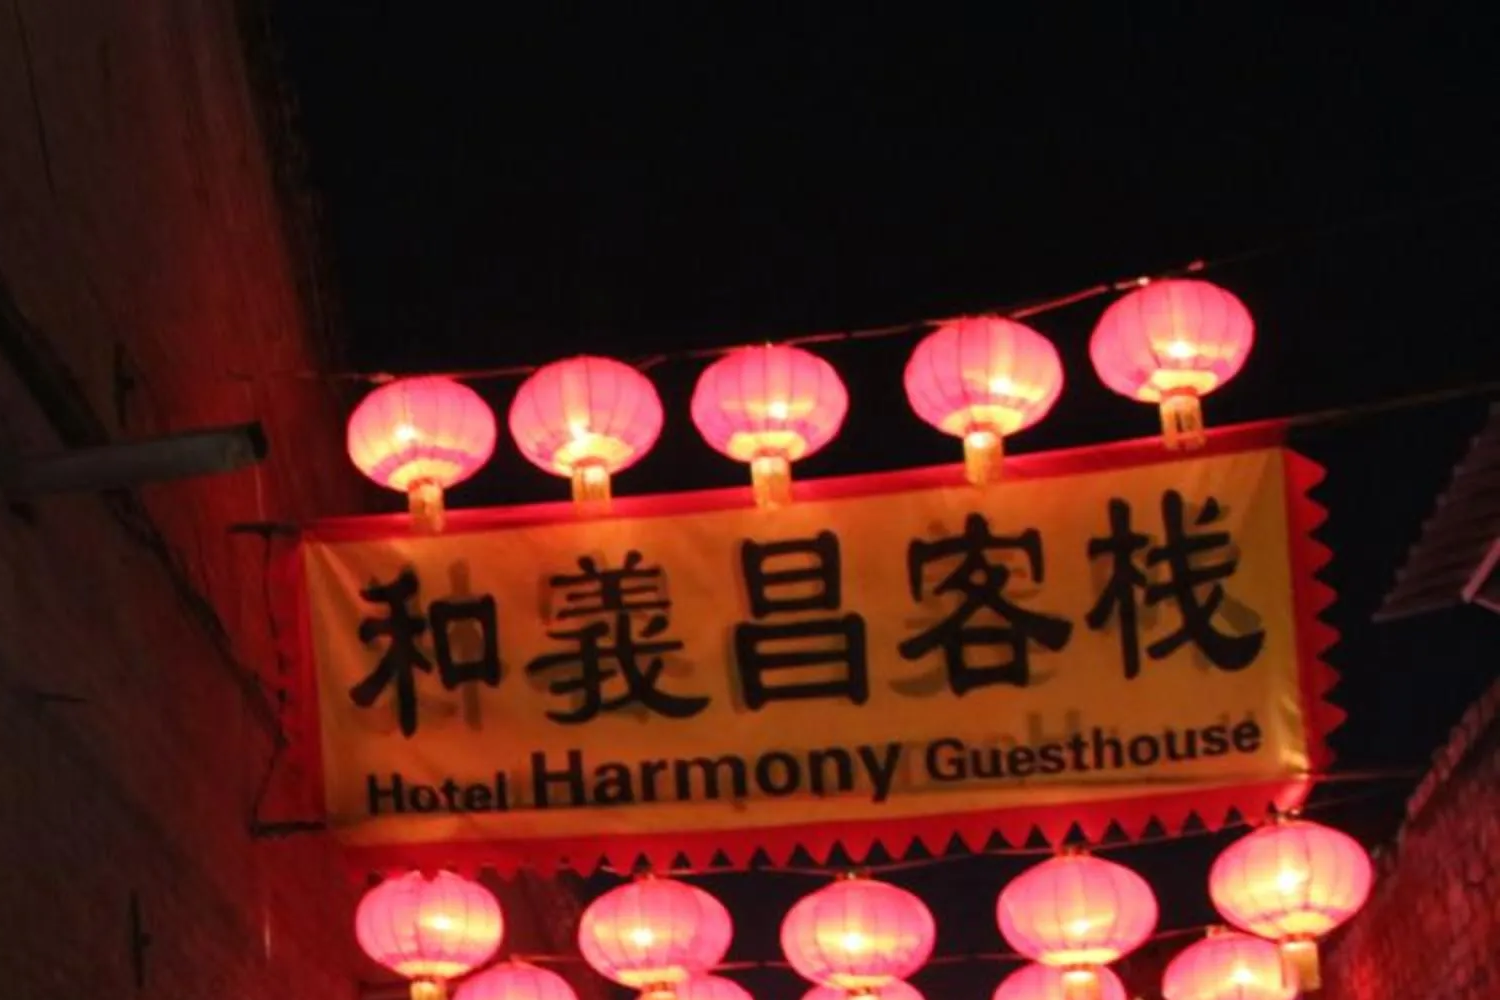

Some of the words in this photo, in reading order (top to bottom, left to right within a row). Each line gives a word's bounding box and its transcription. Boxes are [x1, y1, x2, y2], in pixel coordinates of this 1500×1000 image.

[349, 487, 1265, 737] 和義昌客栈
[366, 770, 509, 816] Hotel
[530, 738, 901, 808] Harmony
[924, 717, 1263, 783] Guesthouse
